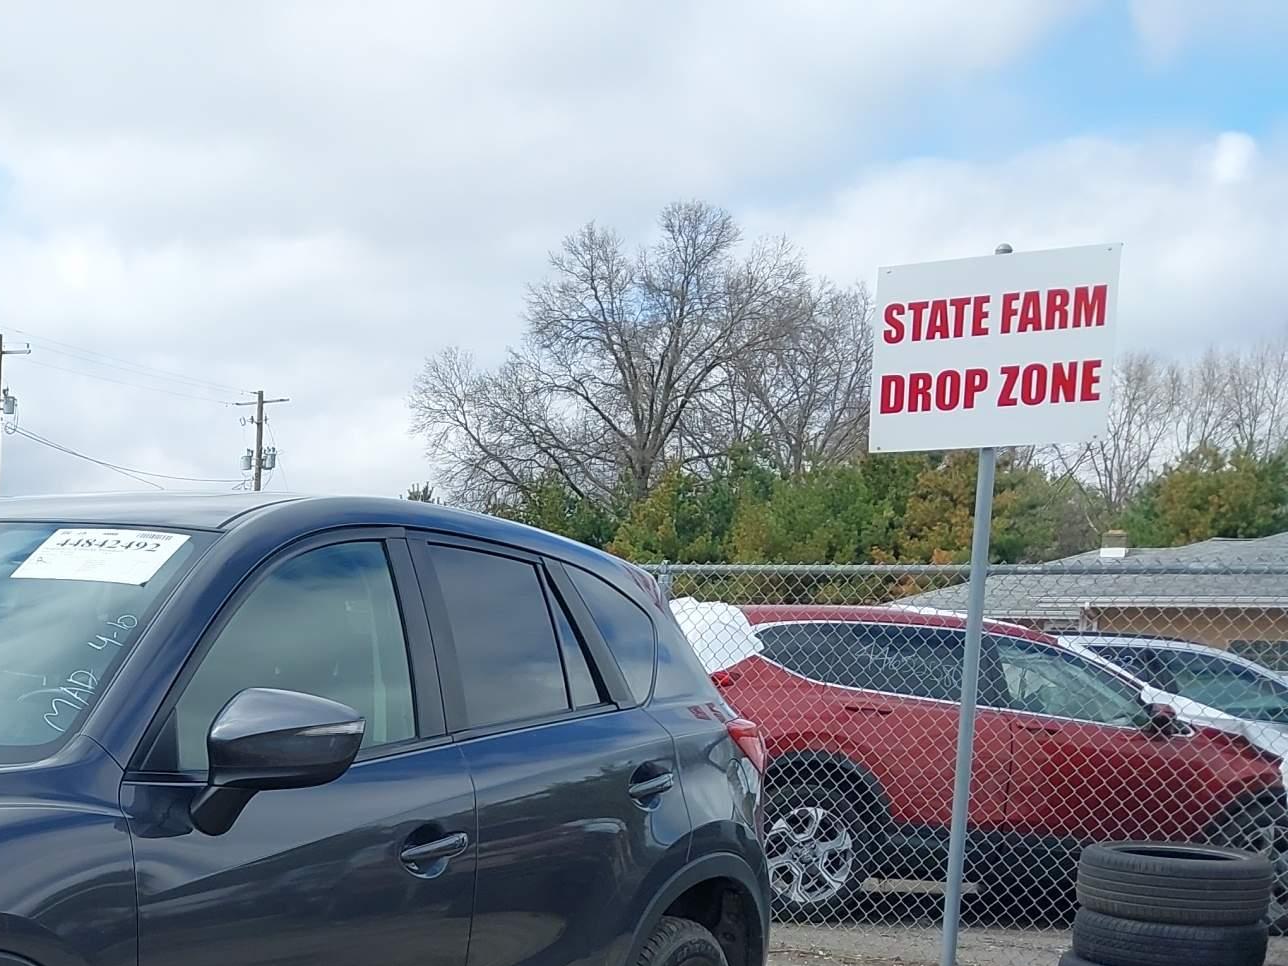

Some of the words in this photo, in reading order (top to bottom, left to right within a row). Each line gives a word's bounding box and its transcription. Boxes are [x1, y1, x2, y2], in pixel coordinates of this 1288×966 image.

[883, 295, 991, 345] STATE
[1000, 284, 1108, 335] FARM
[879, 367, 989, 415] DROP
[997, 359, 1102, 407] ZONE
[56, 537, 161, 553] 44842492
[43, 670, 98, 733] MAD
